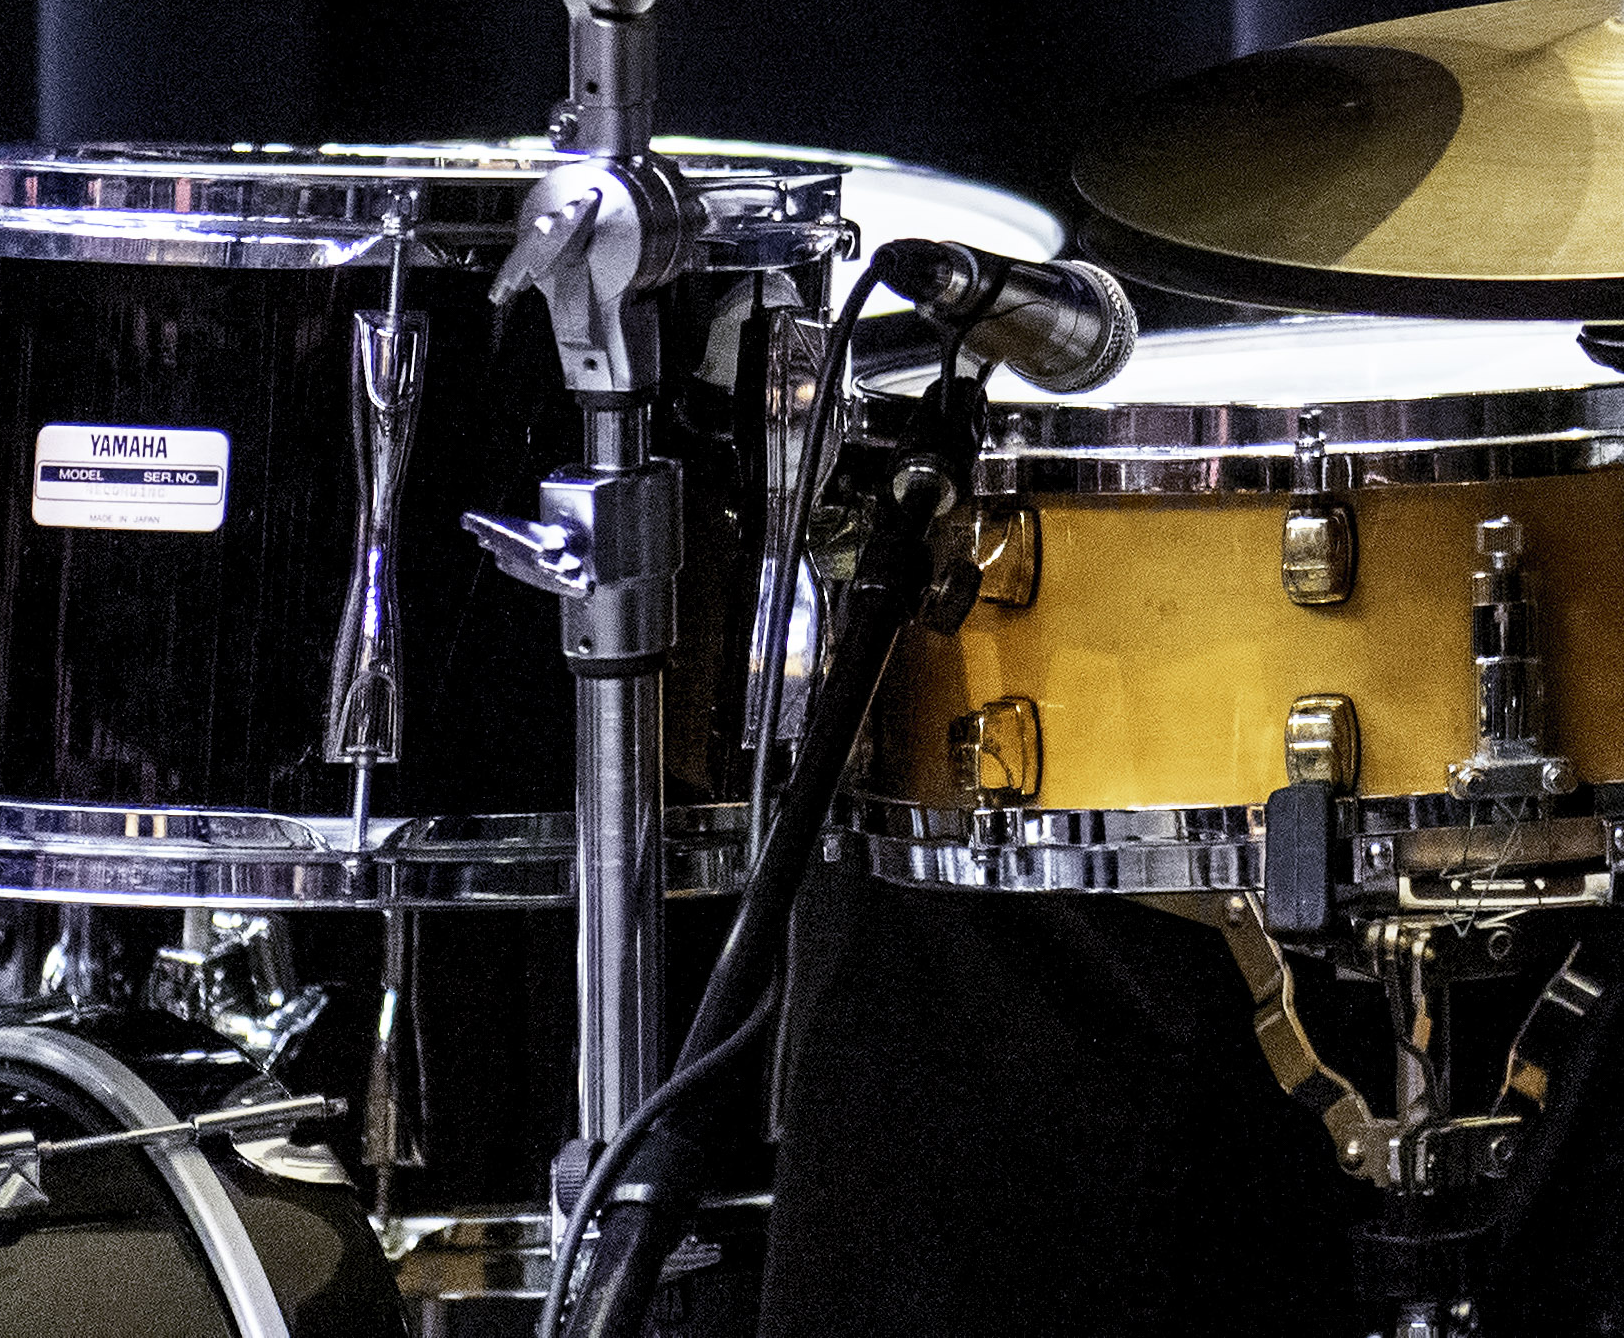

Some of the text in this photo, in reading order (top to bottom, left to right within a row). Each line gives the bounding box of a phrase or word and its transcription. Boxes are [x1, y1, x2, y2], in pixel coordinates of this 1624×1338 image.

[91, 434, 167, 458] YAMAHA
[59, 468, 105, 481] MODEL
[89, 514, 161, 524] MADE IN JAPAN
